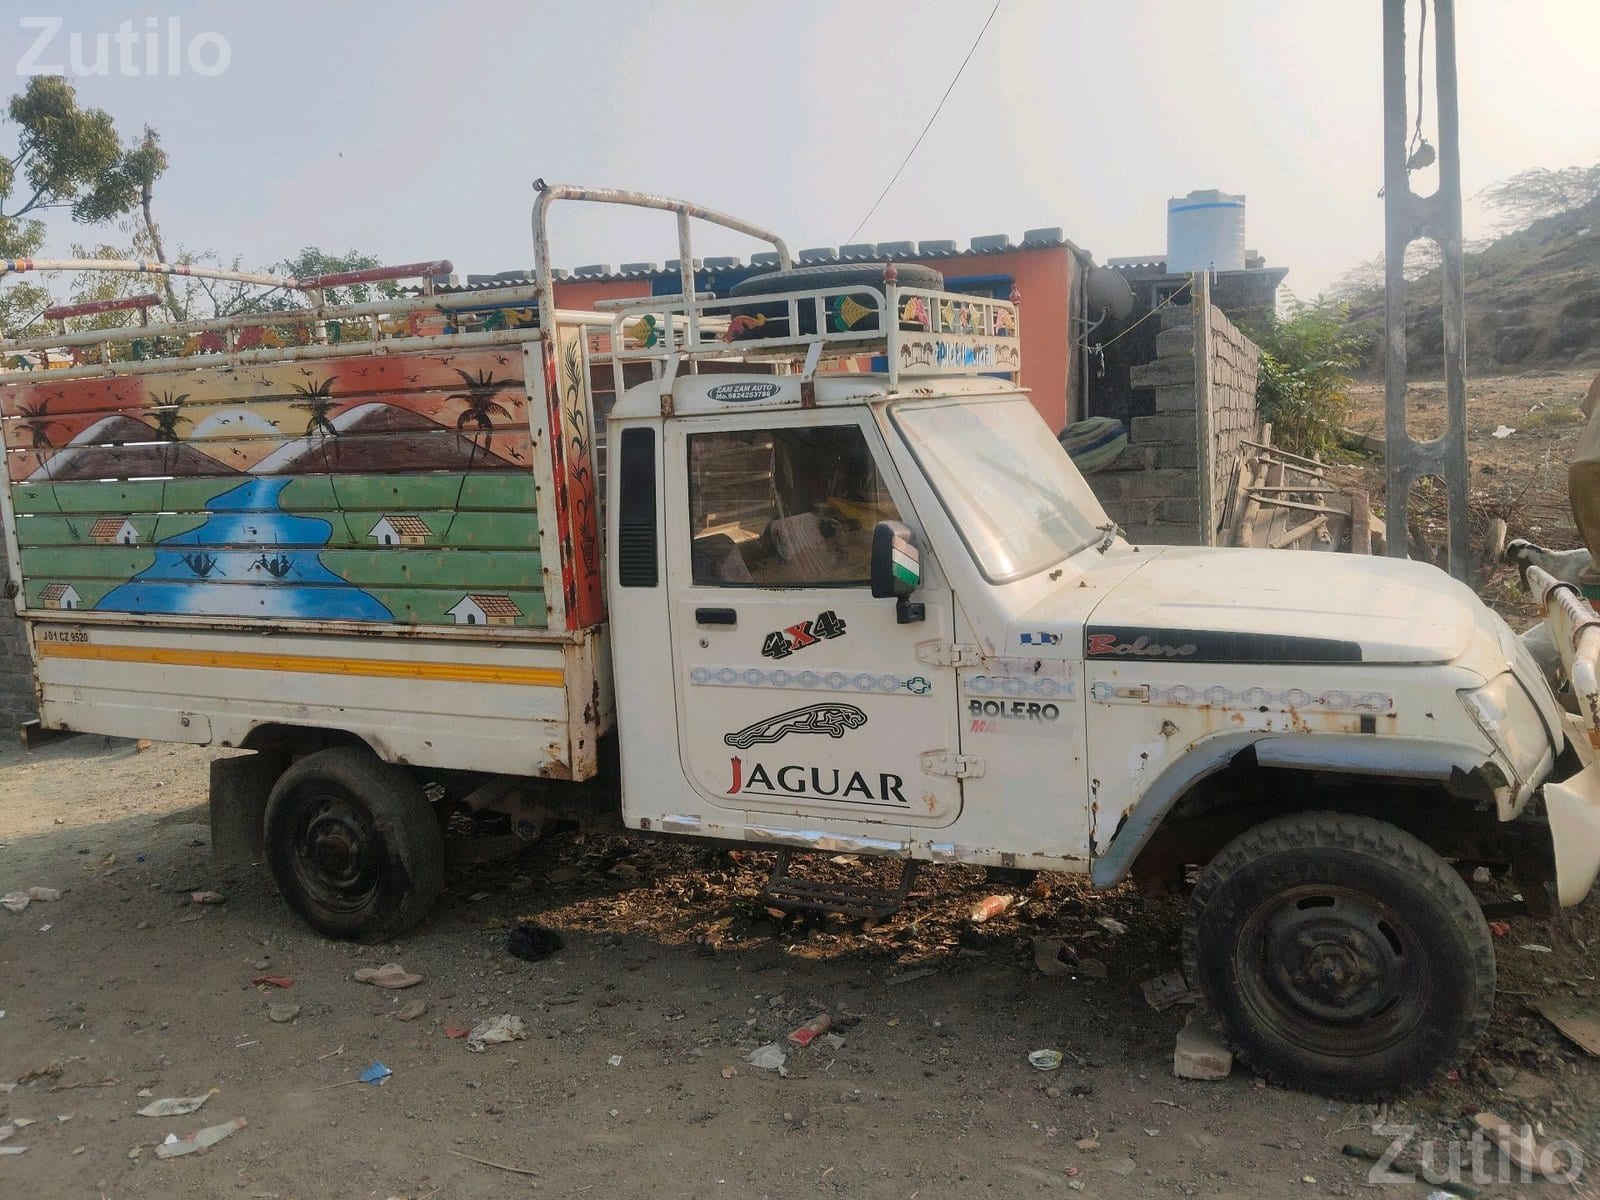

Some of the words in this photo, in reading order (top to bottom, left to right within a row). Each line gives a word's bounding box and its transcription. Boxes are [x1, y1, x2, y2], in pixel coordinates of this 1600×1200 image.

[59, 632, 69, 642] CZ
[70, 633, 89, 643] 9520
[1087, 633, 1198, 656] Bolero
[968, 699, 1060, 723] BOLERO
[726, 756, 908, 803] JAGUAR
